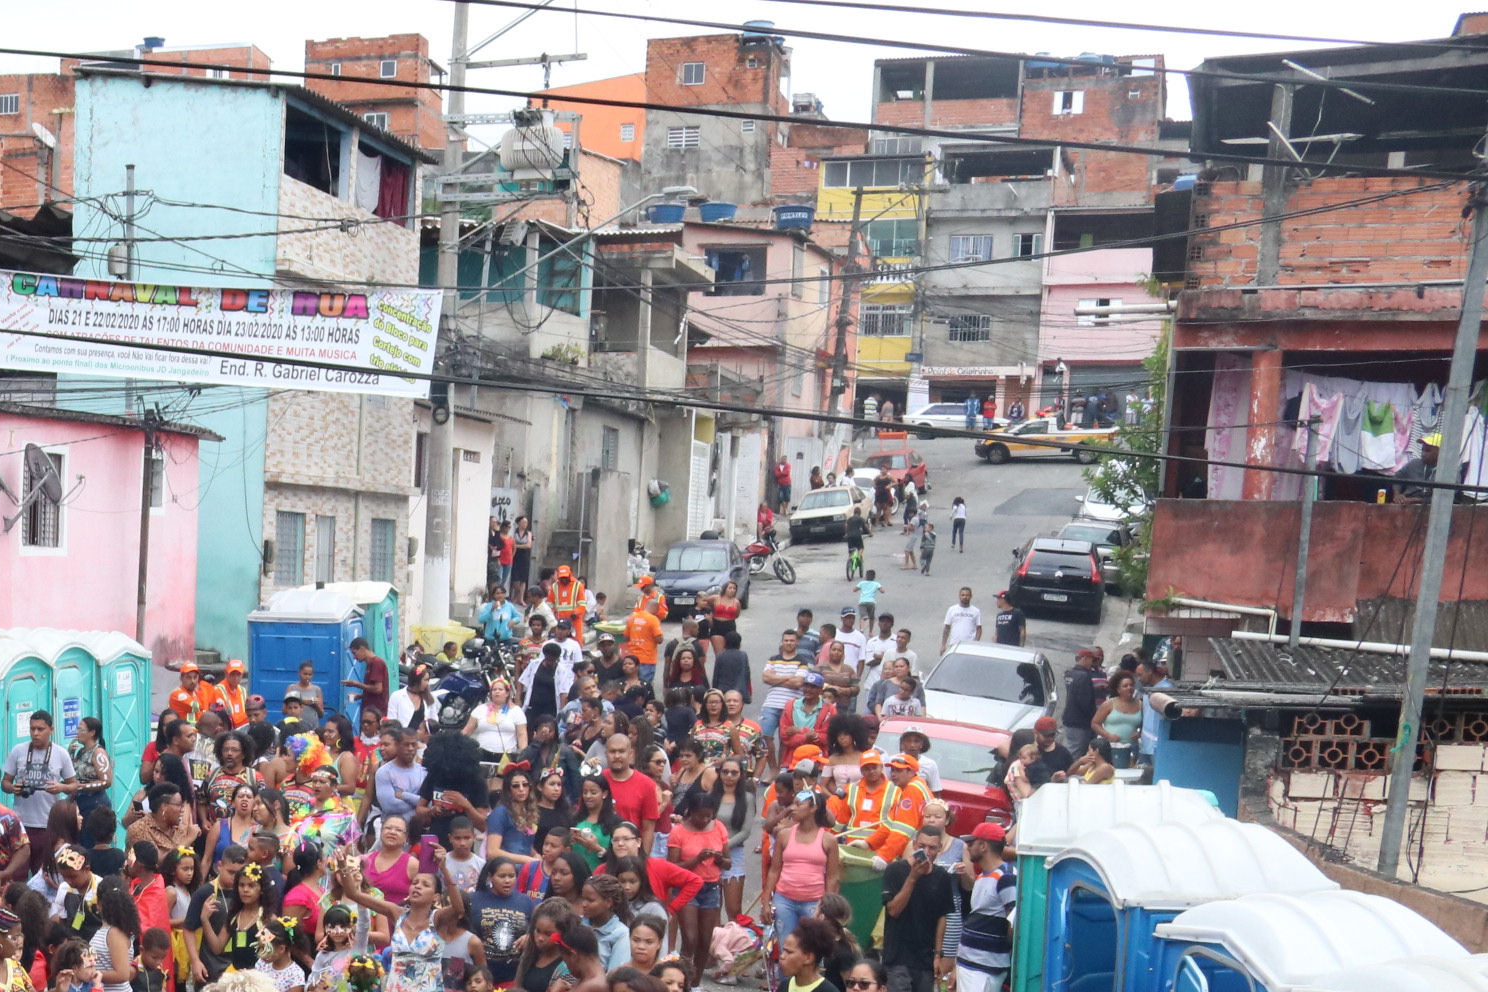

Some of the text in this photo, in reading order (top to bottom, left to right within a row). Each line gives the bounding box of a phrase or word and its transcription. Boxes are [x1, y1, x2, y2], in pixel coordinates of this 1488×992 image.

[12, 273, 370, 319] CARNAVAL DE RUA
[48, 308, 69, 326] DIAS
[71, 310, 82, 326] 21
[85, 311, 92, 327] E
[92, 311, 140, 329] 22/02/2020
[157, 316, 180, 333] 17:00
[183, 318, 214, 336] HORAS
[217, 320, 232, 337] DIA
[235, 321, 282, 340] 23/02/2020
[301, 326, 325, 343] 13:00
[327, 327, 360, 344] HORAS
[376, 299, 433, 334] Concentração
[34, 344, 63, 354] Contamos
[64, 347, 76, 355] com
[77, 348, 87, 356] sua
[192, 341, 205, 350] DA
[207, 342, 274, 354] COMUNIDADE
[277, 345, 282, 355] E
[286, 346, 316, 357] MUITA
[319, 347, 357, 360] MÚSICA
[373, 318, 428, 352] do Bloco para
[52, 359, 73, 367] ponto
[373, 336, 421, 368] Cortejo com
[220, 360, 249, 376] End.
[254, 363, 268, 378] R.
[272, 364, 320, 381] Gabriel
